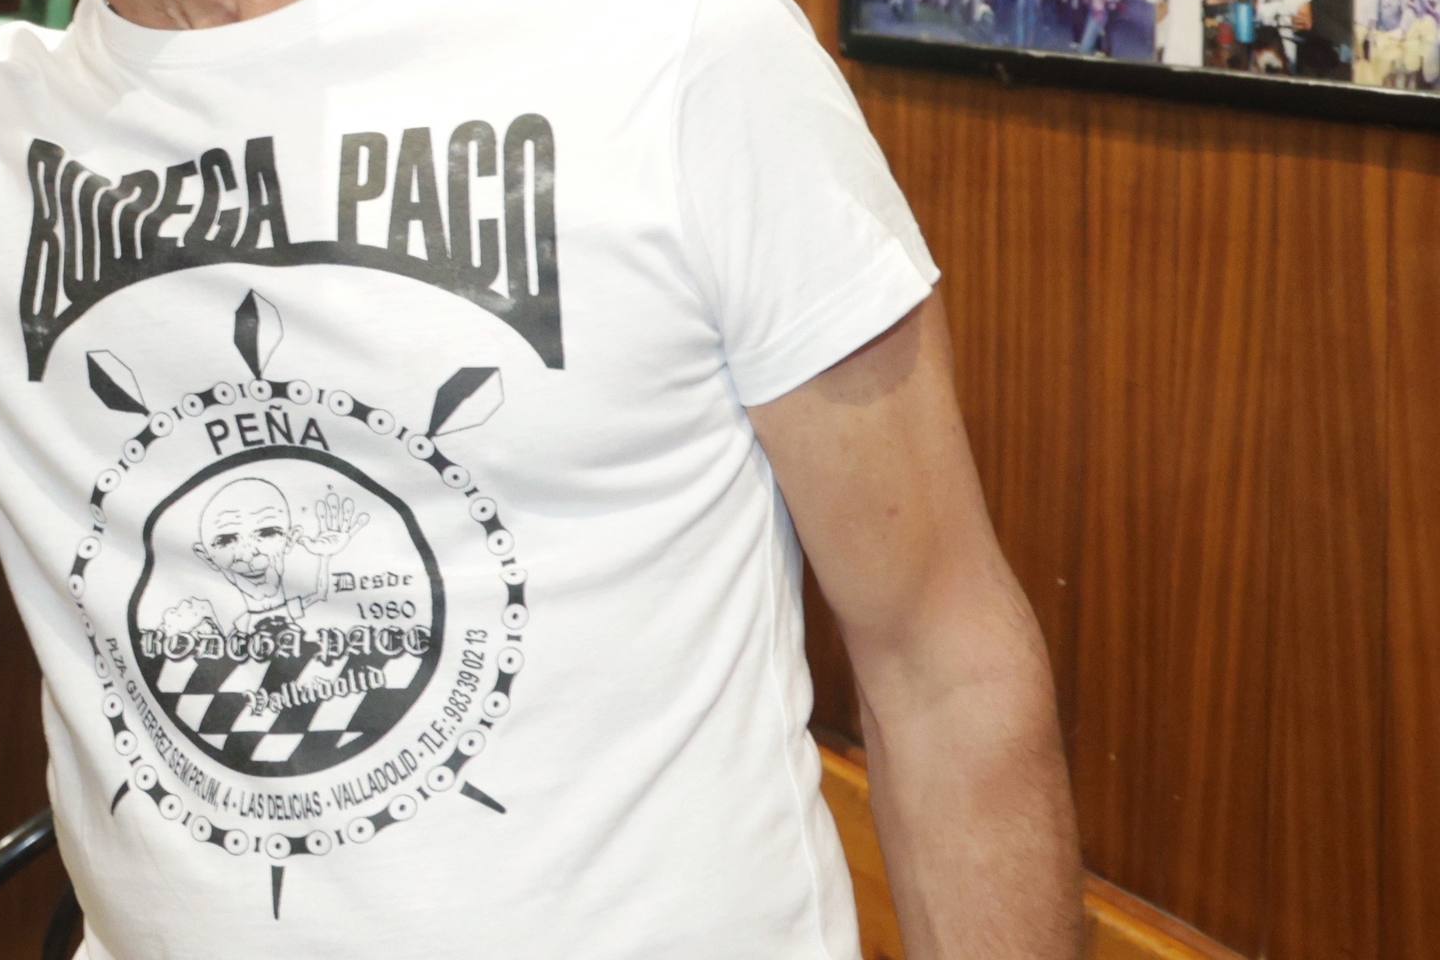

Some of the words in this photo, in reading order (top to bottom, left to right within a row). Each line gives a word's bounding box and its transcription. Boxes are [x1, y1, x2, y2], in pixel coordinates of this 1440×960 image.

[19, 136, 291, 382] BODEGA
[336, 112, 566, 370] PACO
[204, 403, 330, 456] PEÑA
[331, 571, 414, 592] Desde
[356, 600, 417, 620] 1980
[464, 629, 488, 645] 13
[461, 649, 486, 670] 02
[246, 664, 386, 717] Valladolid
[330, 748, 418, 811] VALLADOLID
[240, 791, 264, 819] LAS
[267, 791, 323, 821] DELICIAS
